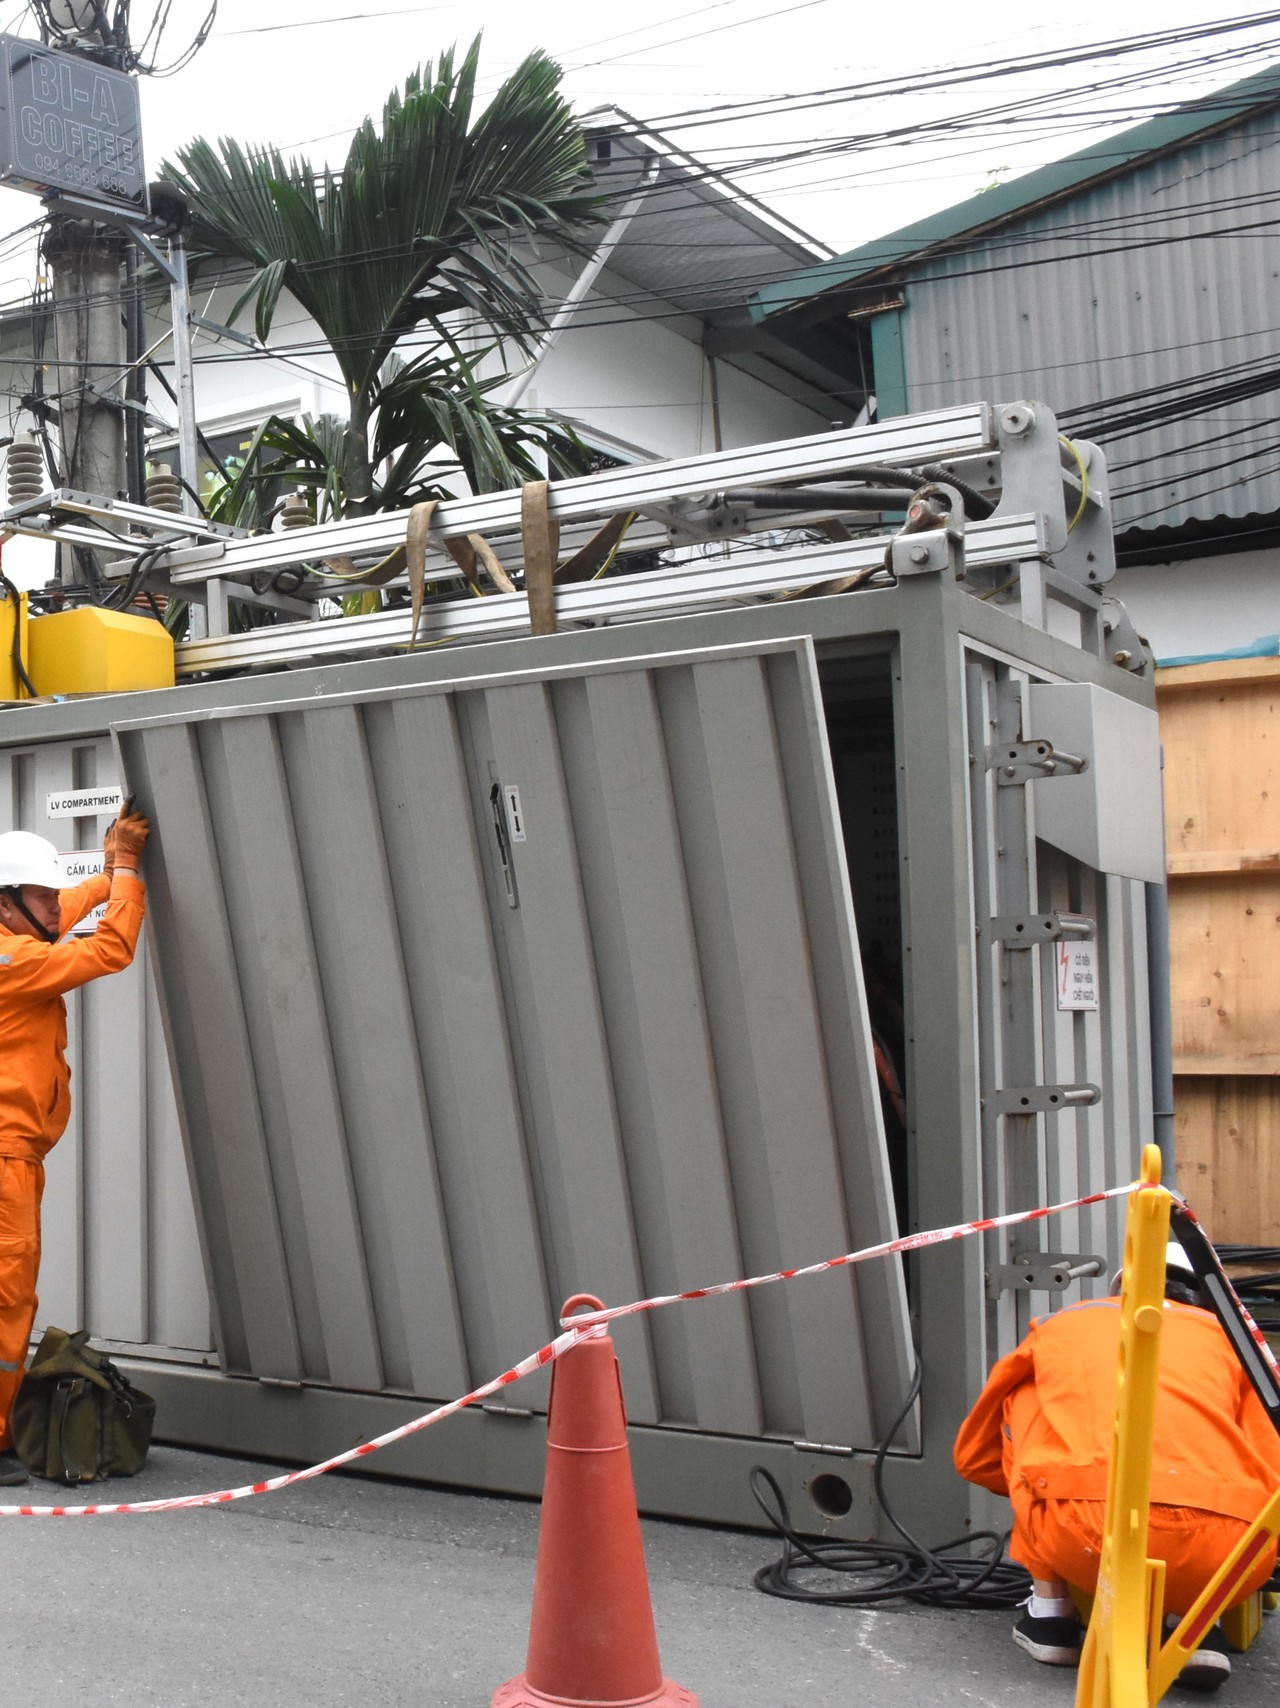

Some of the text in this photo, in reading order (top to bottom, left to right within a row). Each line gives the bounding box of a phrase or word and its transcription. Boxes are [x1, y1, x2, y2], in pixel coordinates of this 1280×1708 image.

[29, 53, 118, 127] BI-A
[21, 105, 136, 176] COFFEE
[51, 795, 120, 810] LV COMPARTMENT
[66, 861, 86, 876] CẤM
